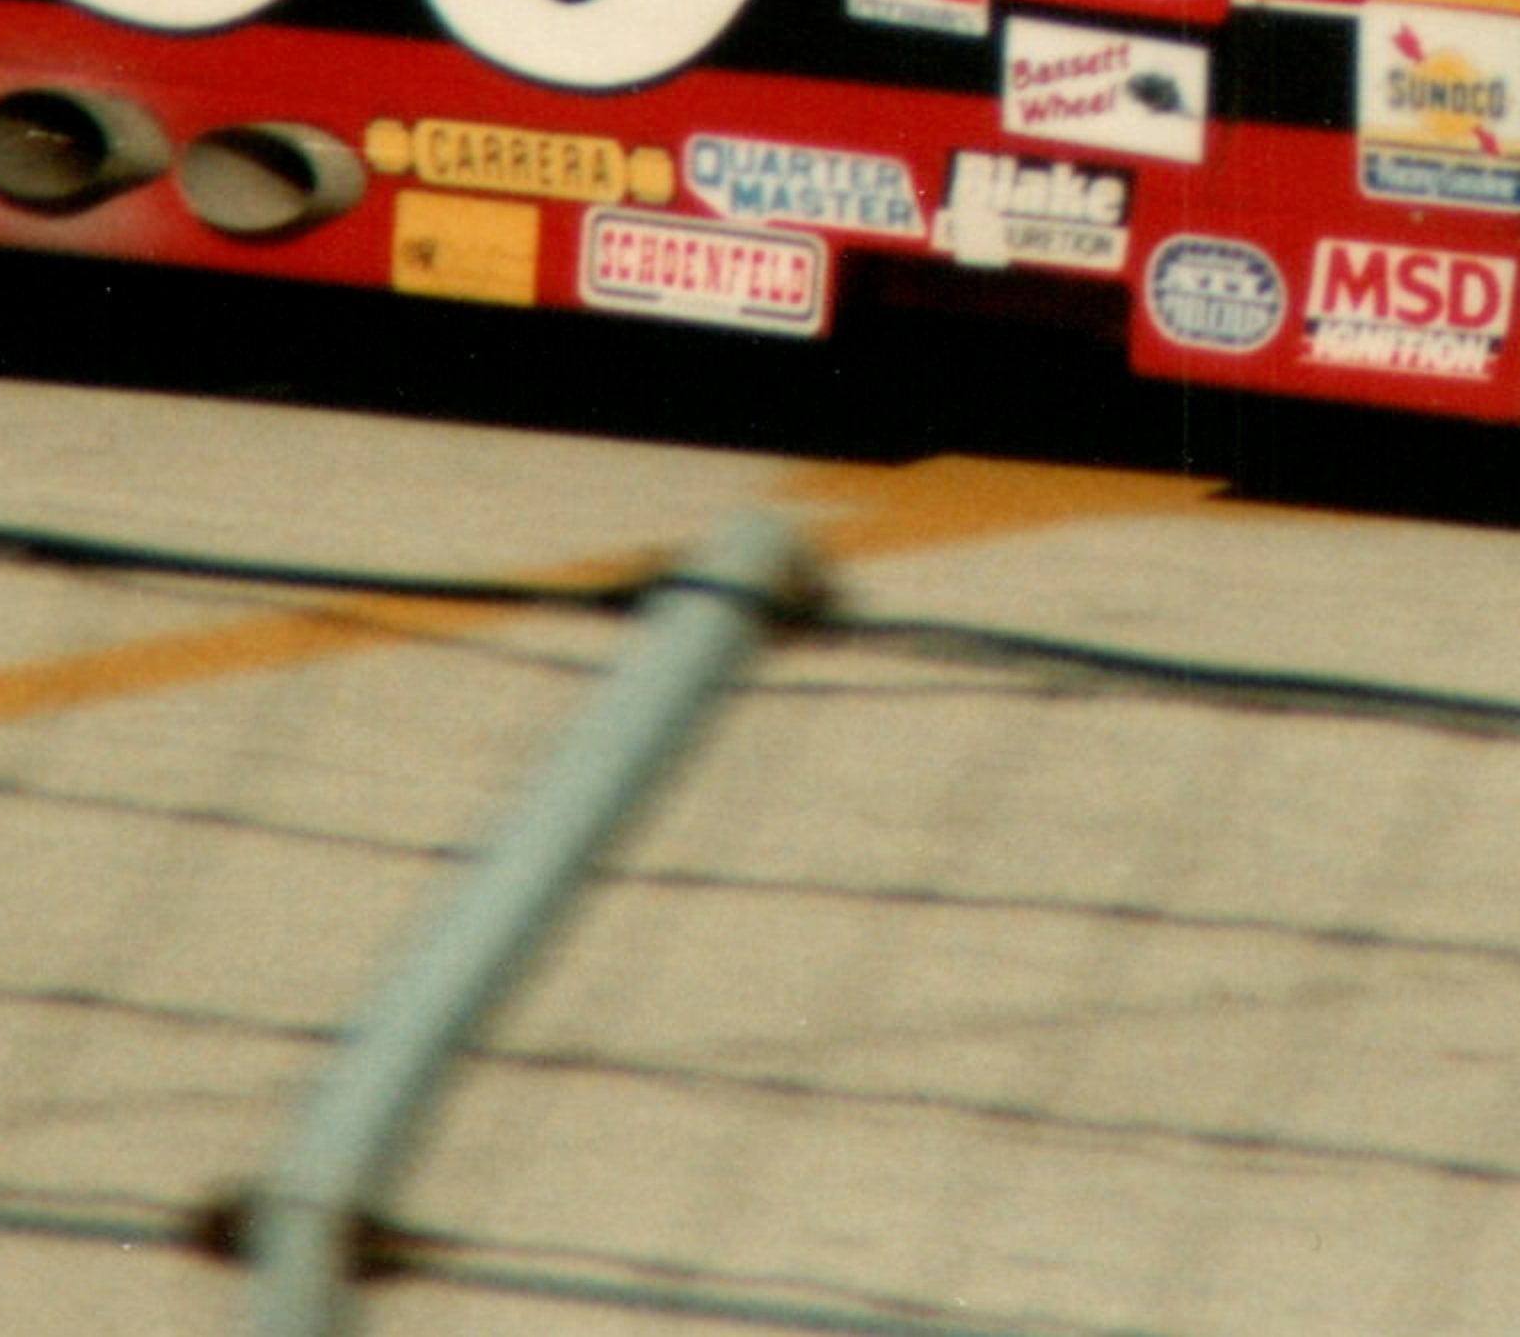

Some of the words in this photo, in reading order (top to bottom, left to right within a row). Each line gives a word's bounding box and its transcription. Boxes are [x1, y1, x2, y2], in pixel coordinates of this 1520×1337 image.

[1013, 43, 1131, 92] Bassett
[1020, 89, 1119, 125] Wheel
[1386, 68, 1507, 120] SUNOCO
[427, 127, 611, 190] CARRERA
[692, 138, 902, 190] QUARTER
[731, 179, 914, 228] MASTER
[597, 228, 808, 306] SCHOENFELD
[1323, 245, 1502, 329] MSD
